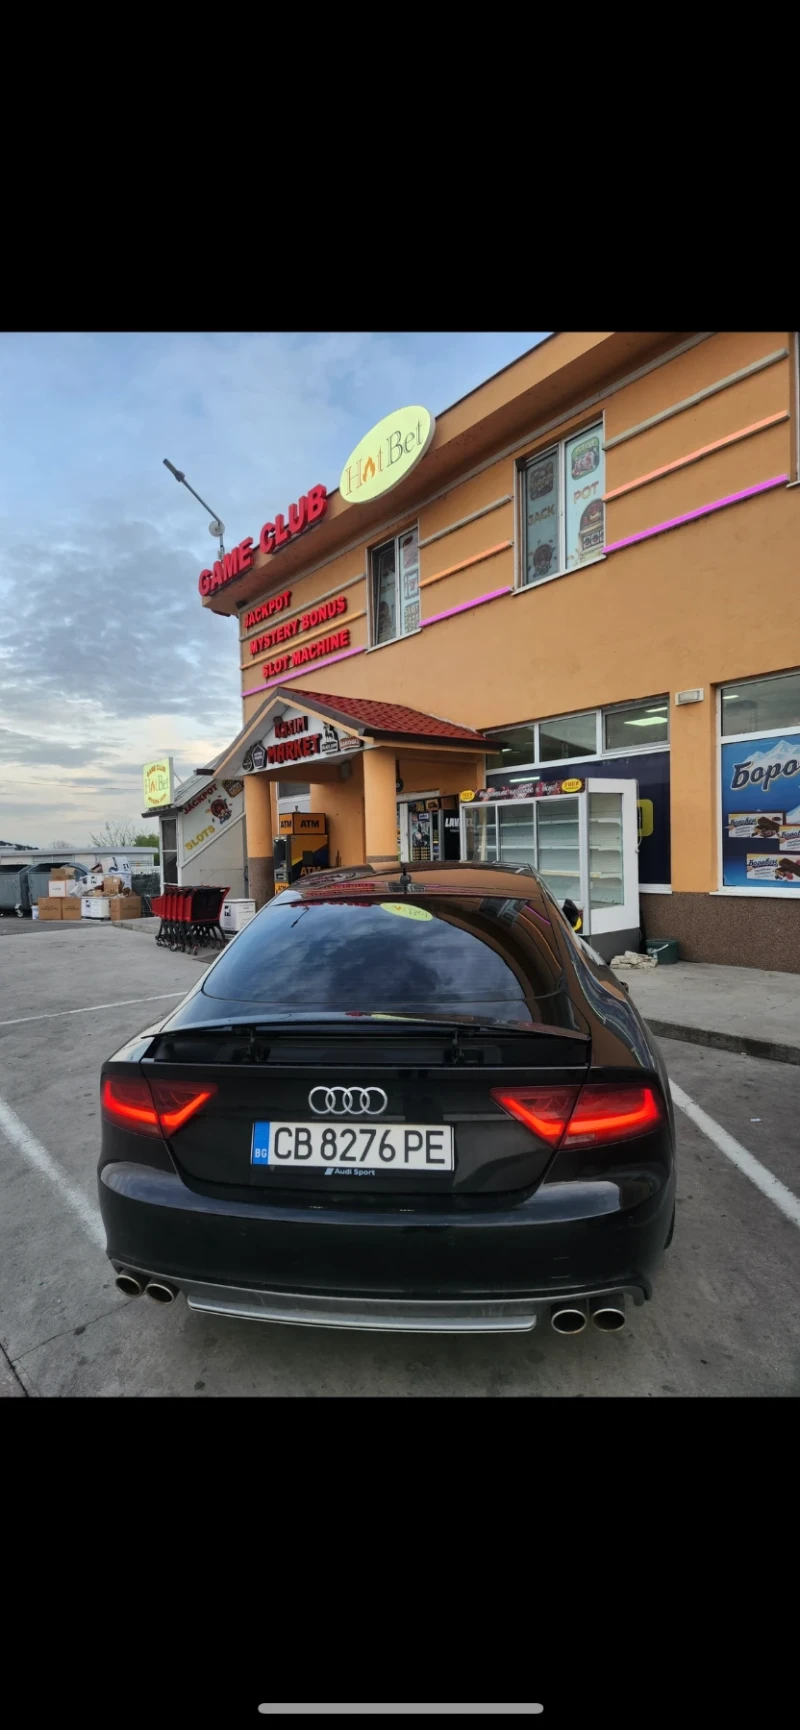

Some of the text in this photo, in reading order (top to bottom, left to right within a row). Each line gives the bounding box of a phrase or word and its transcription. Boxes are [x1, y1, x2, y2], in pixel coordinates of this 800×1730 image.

[385, 418, 423, 468] Bet
[573, 480, 599, 504] POT
[527, 504, 555, 527] JACK
[198, 483, 328, 597] GAME CLUB
[243, 590, 293, 629] JACKPOT
[249, 595, 348, 655] MYSTERY BONUS
[262, 628, 351, 679] SLOT MACHINE
[274, 716, 308, 739] KASIM
[267, 733, 322, 764] MARKET
[730, 758, 800, 791] Боро
[183, 783, 218, 815] JACKPOT
[185, 825, 216, 851] SLOTS
[281, 819, 292, 828] ATM
[300, 819, 320, 828] ATM
[254, 1126, 446, 1164] BG CB 8276 PE
[334, 1168, 376, 1177] Audi Sport
